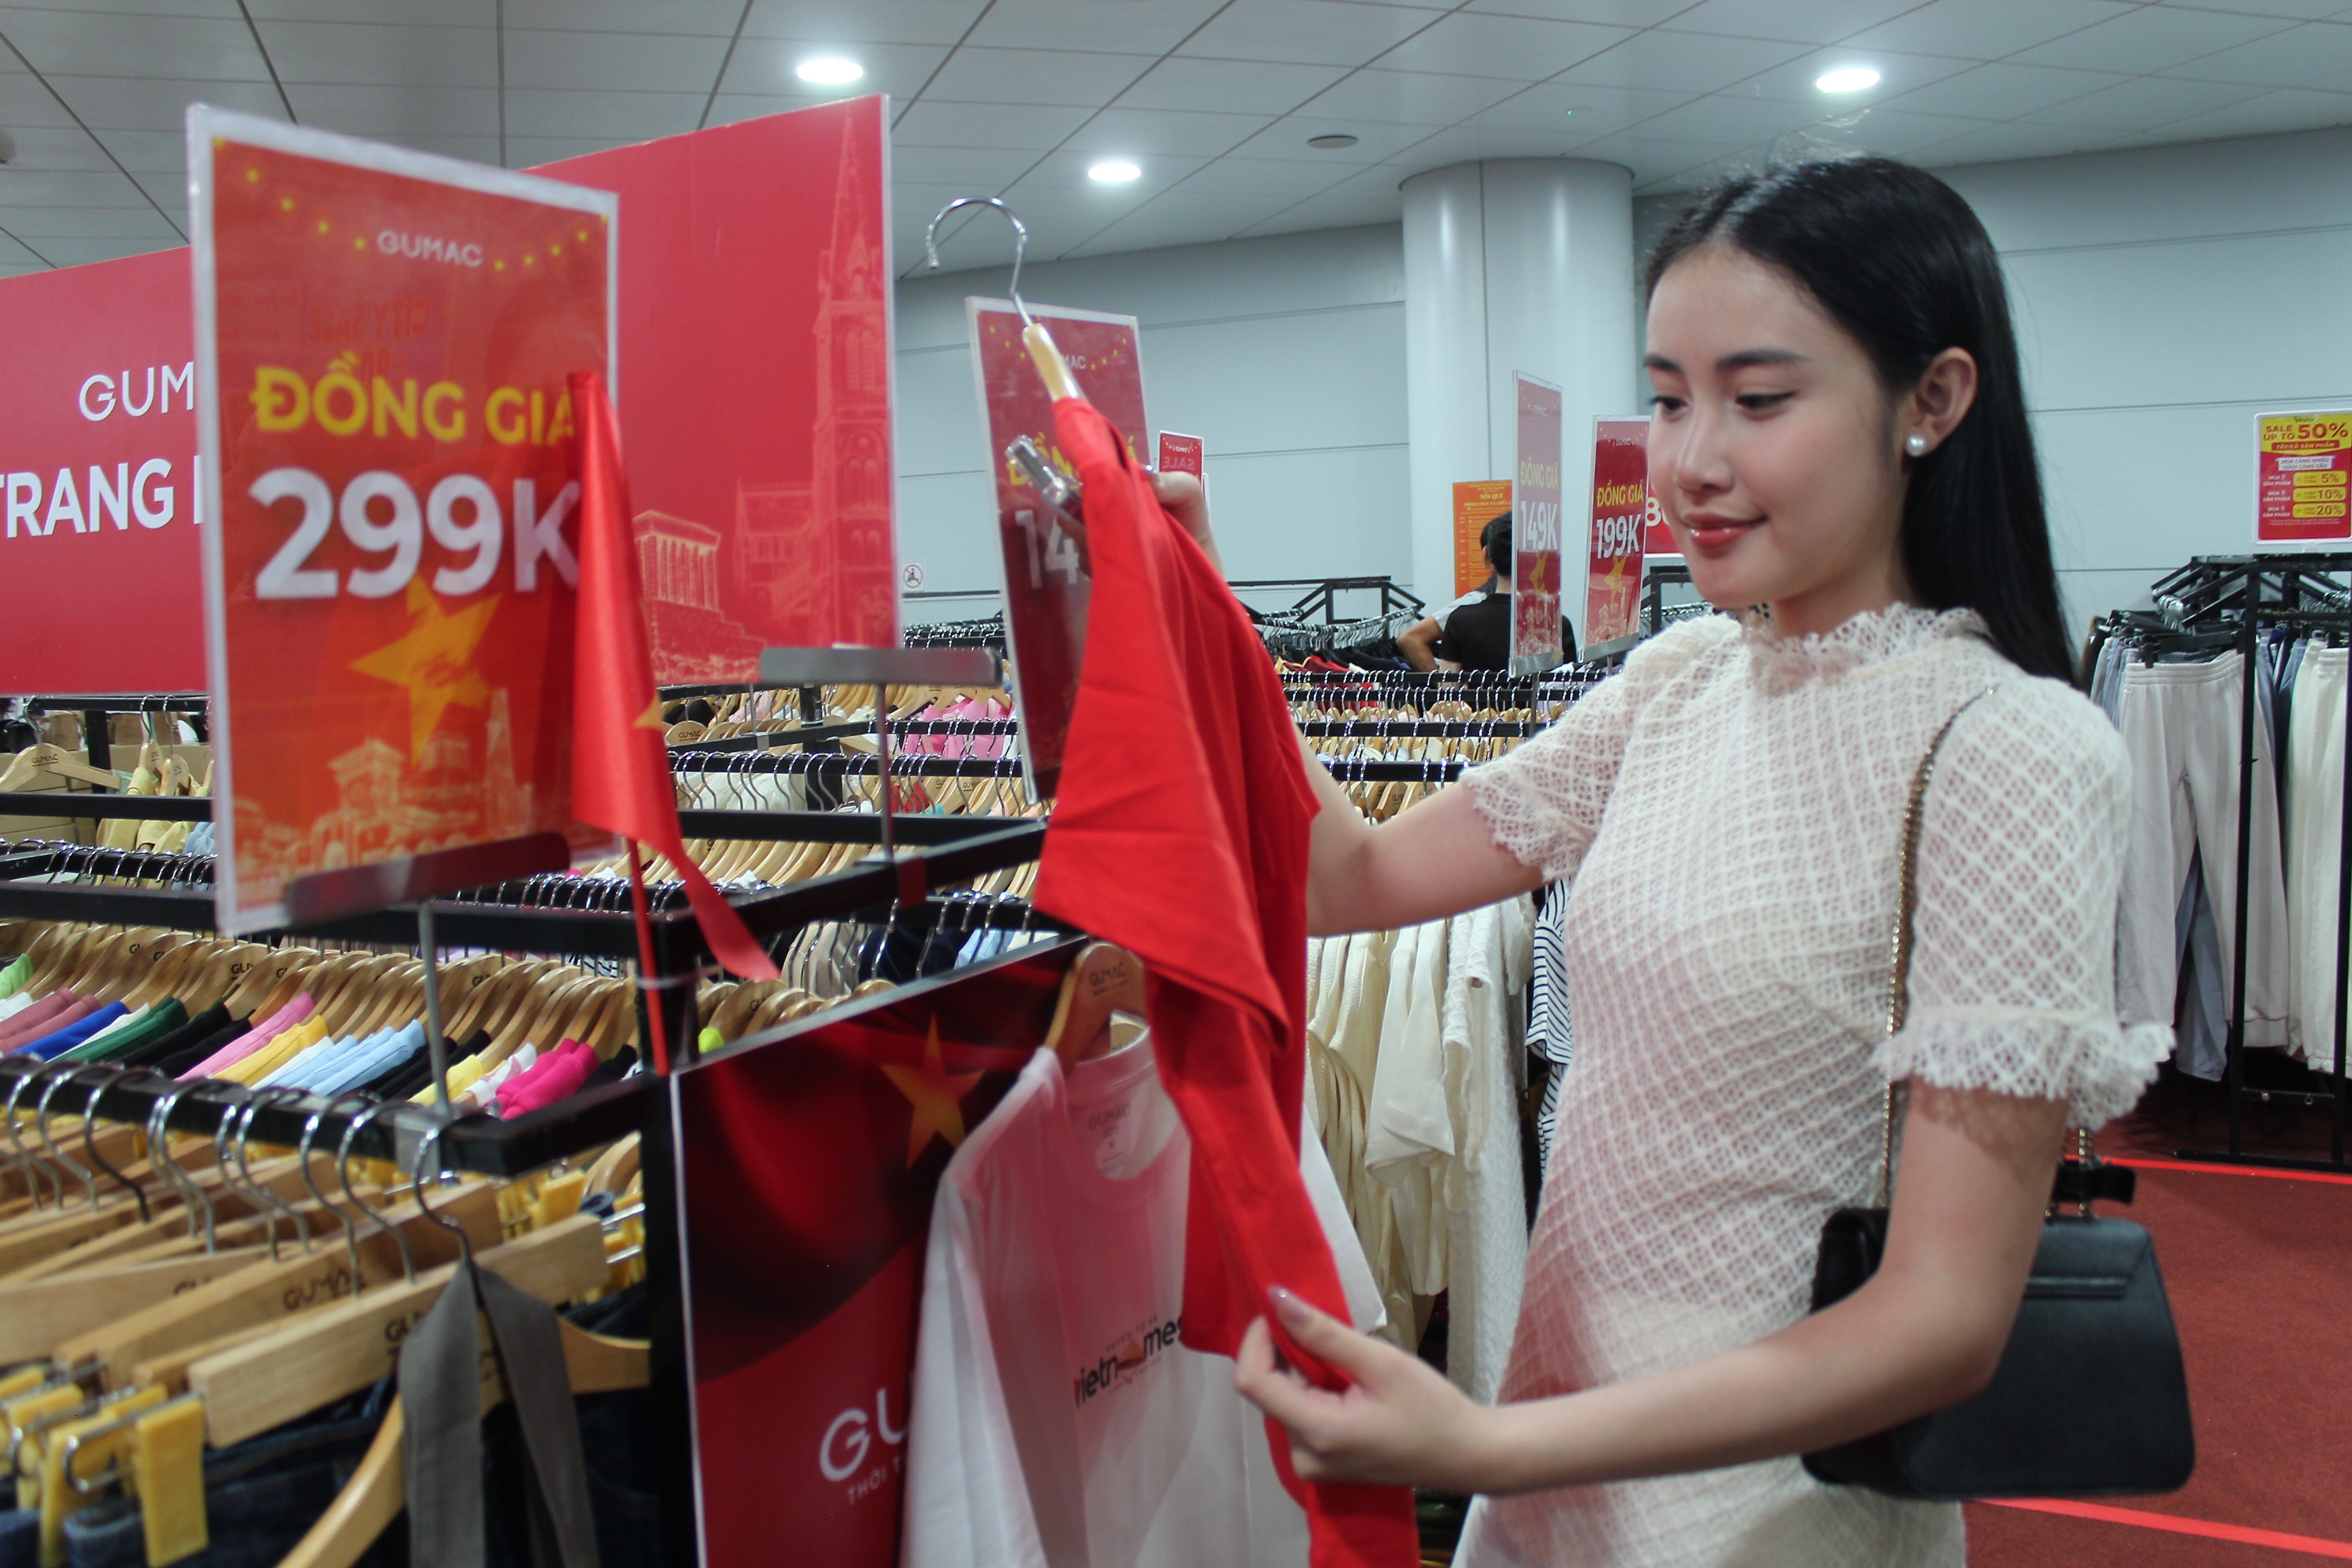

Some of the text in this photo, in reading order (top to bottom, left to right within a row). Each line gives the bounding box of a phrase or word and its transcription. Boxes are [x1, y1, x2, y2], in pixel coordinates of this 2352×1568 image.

[377, 229, 483, 267] GUMAC
[78, 361, 194, 422] GUM
[248, 350, 467, 445] ĐỒNG
[2298, 422, 2348, 439] 50%
[1597, 479, 1644, 508] ĐỒNG GIÁ
[2317, 489, 2343, 500] 10%
[2321, 473, 2339, 484] 5%
[0, 458, 174, 538] RANG
[2317, 505, 2342, 515] 20%
[248, 466, 581, 600] 299K
[1521, 501, 1558, 551] 149K
[1597, 514, 1642, 559] 199K
[679, 730, 701, 738] GUMAC
[31, 754, 59, 764] GUMAC
